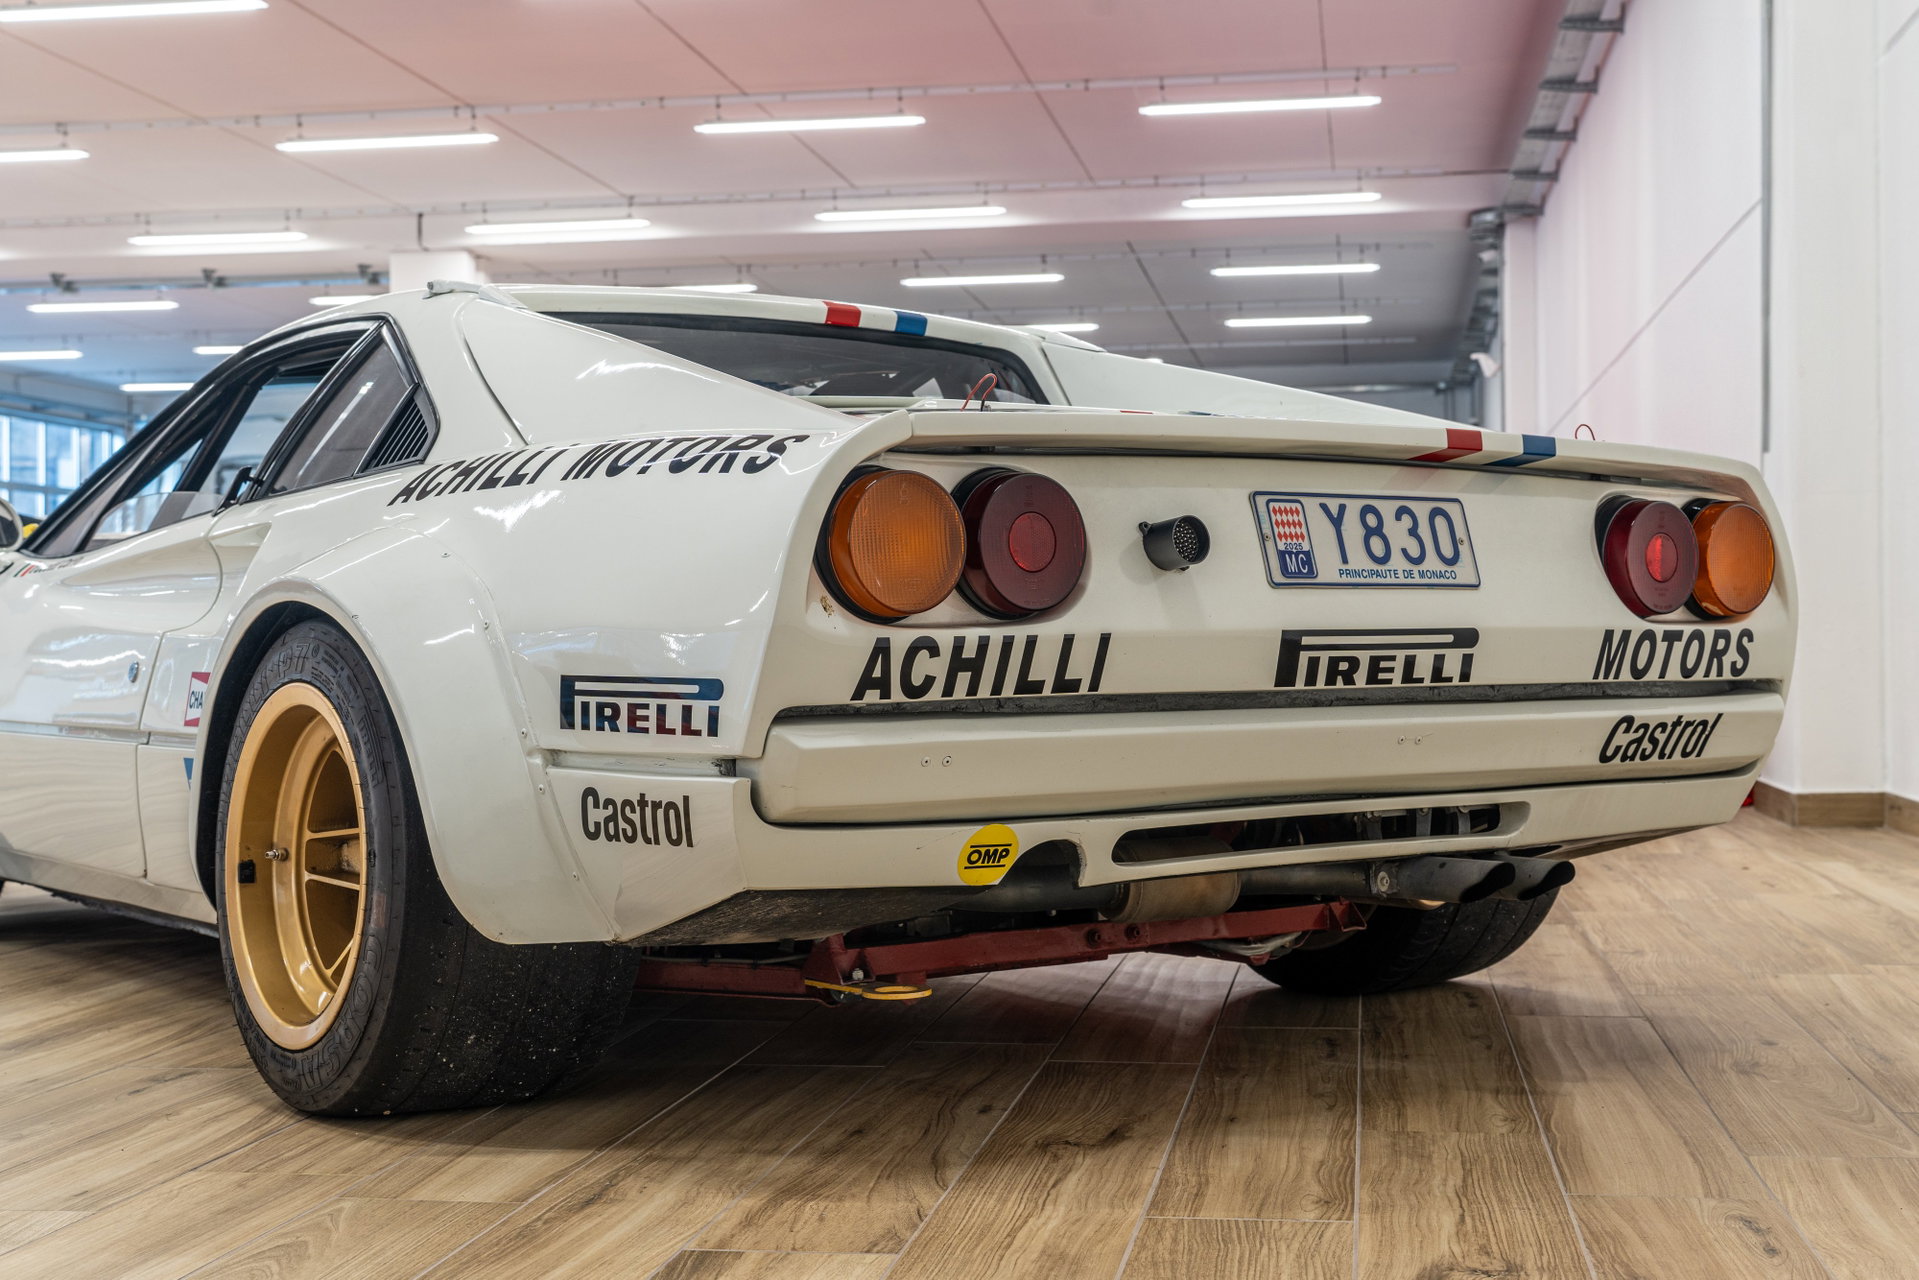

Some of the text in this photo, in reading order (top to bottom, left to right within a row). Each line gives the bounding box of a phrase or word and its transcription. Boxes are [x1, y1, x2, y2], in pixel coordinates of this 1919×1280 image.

[387, 434, 810, 507] ACHILLI MOTORS
[1283, 542, 1304, 551] 2025
[1285, 553, 1309, 574] MC
[1319, 502, 1460, 567] Y830
[1338, 568, 1457, 580] PRINCIPAUTE DE MONACO
[849, 627, 1754, 701] ACHILLI MOTORS
[1273, 627, 1480, 688] PIRELLI
[560, 674, 725, 738] PIRELLI
[1598, 713, 1723, 764] Castrol
[581, 786, 694, 848] Castrol
[966, 847, 1010, 865] OMP
